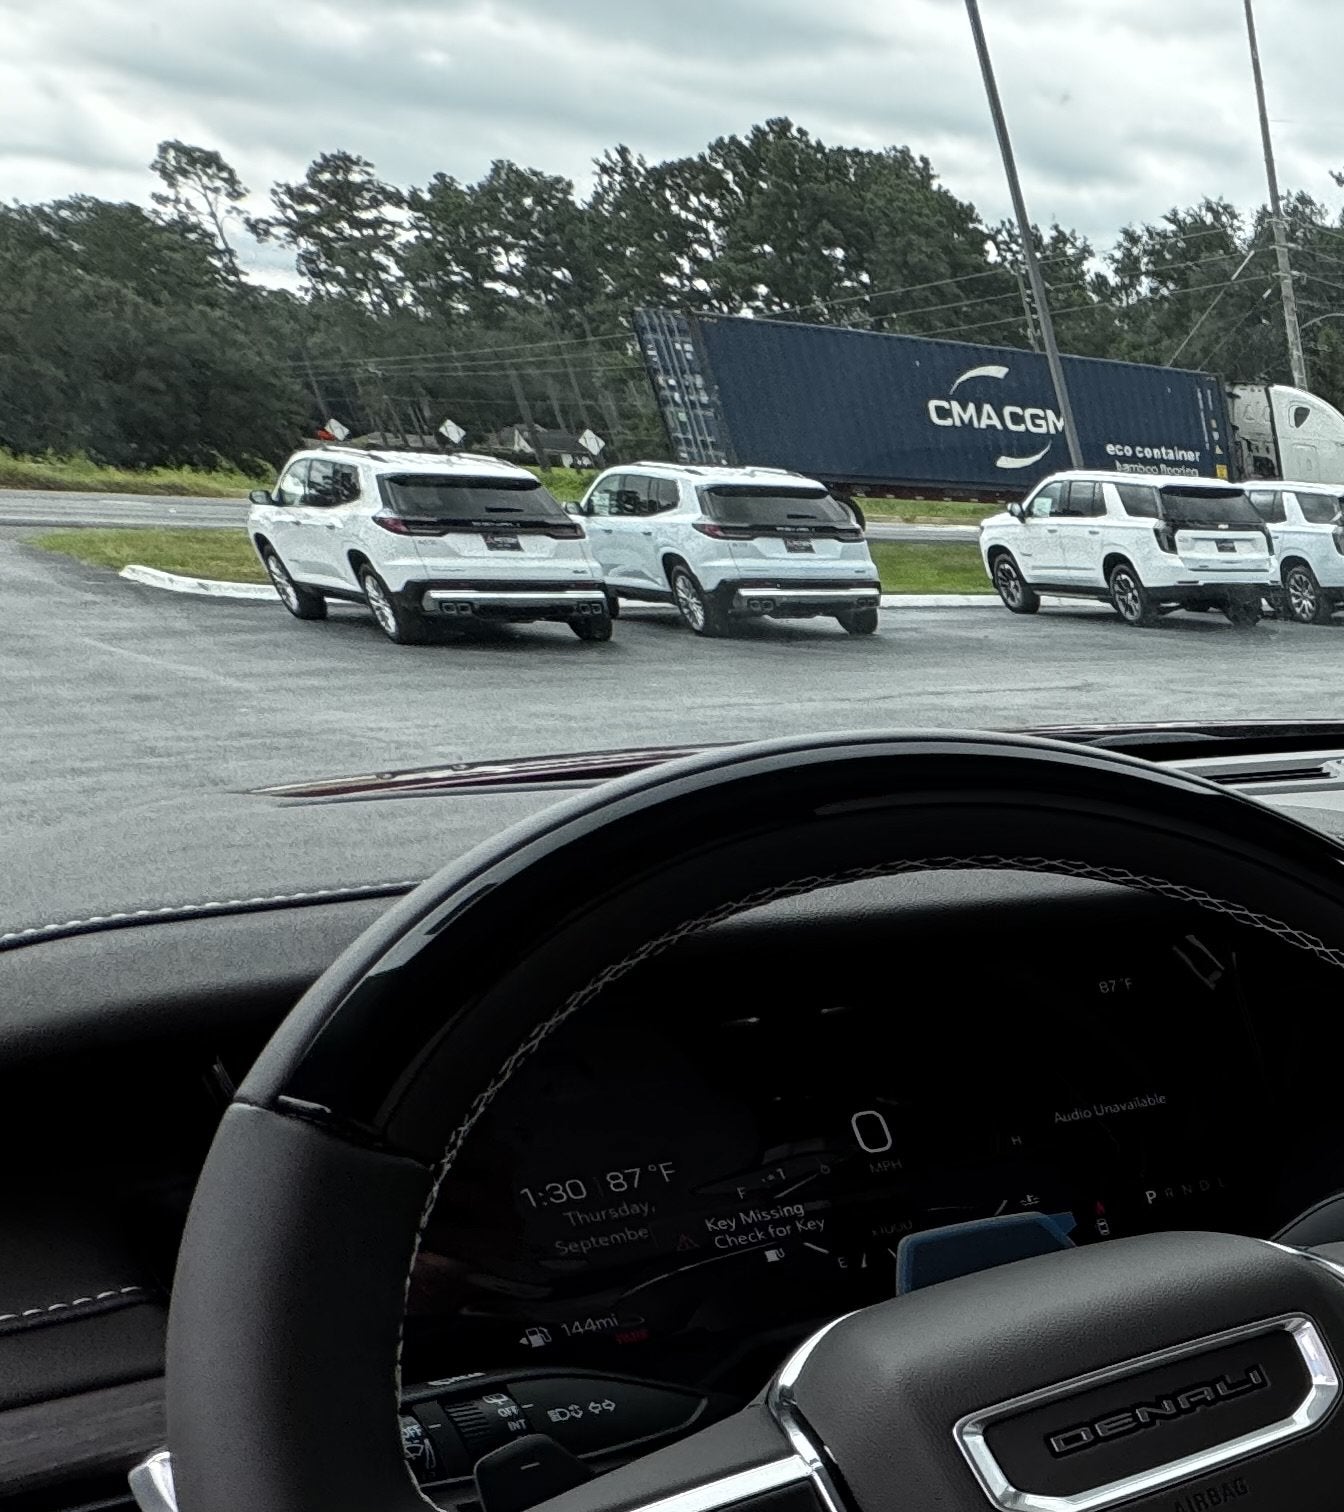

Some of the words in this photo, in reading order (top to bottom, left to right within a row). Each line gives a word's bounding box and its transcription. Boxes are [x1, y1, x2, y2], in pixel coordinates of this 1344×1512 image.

[928, 399, 1003, 431] CMA
[1003, 405, 1064, 434] CGM
[1105, 442, 1132, 457] eco
[1135, 446, 1201, 463] container
[1053, 1107, 1092, 1125] Audio
[851, 1110, 893, 1152] 0
[868, 1159, 904, 1176] MPH
[520, 1177, 588, 1209] 1:30
[1145, 1189, 1157, 1205] P
[703, 1215, 738, 1234] Key
[739, 1203, 806, 1226] Missing
[554, 1228, 651, 1257] Septembe
[713, 1230, 766, 1250] Check
[766, 1222, 793, 1238] for
[795, 1217, 826, 1234] Key
[498, 1405, 520, 1418] OFF
[1046, 1363, 1271, 1458] DENALI
[507, 1419, 528, 1433] INT
